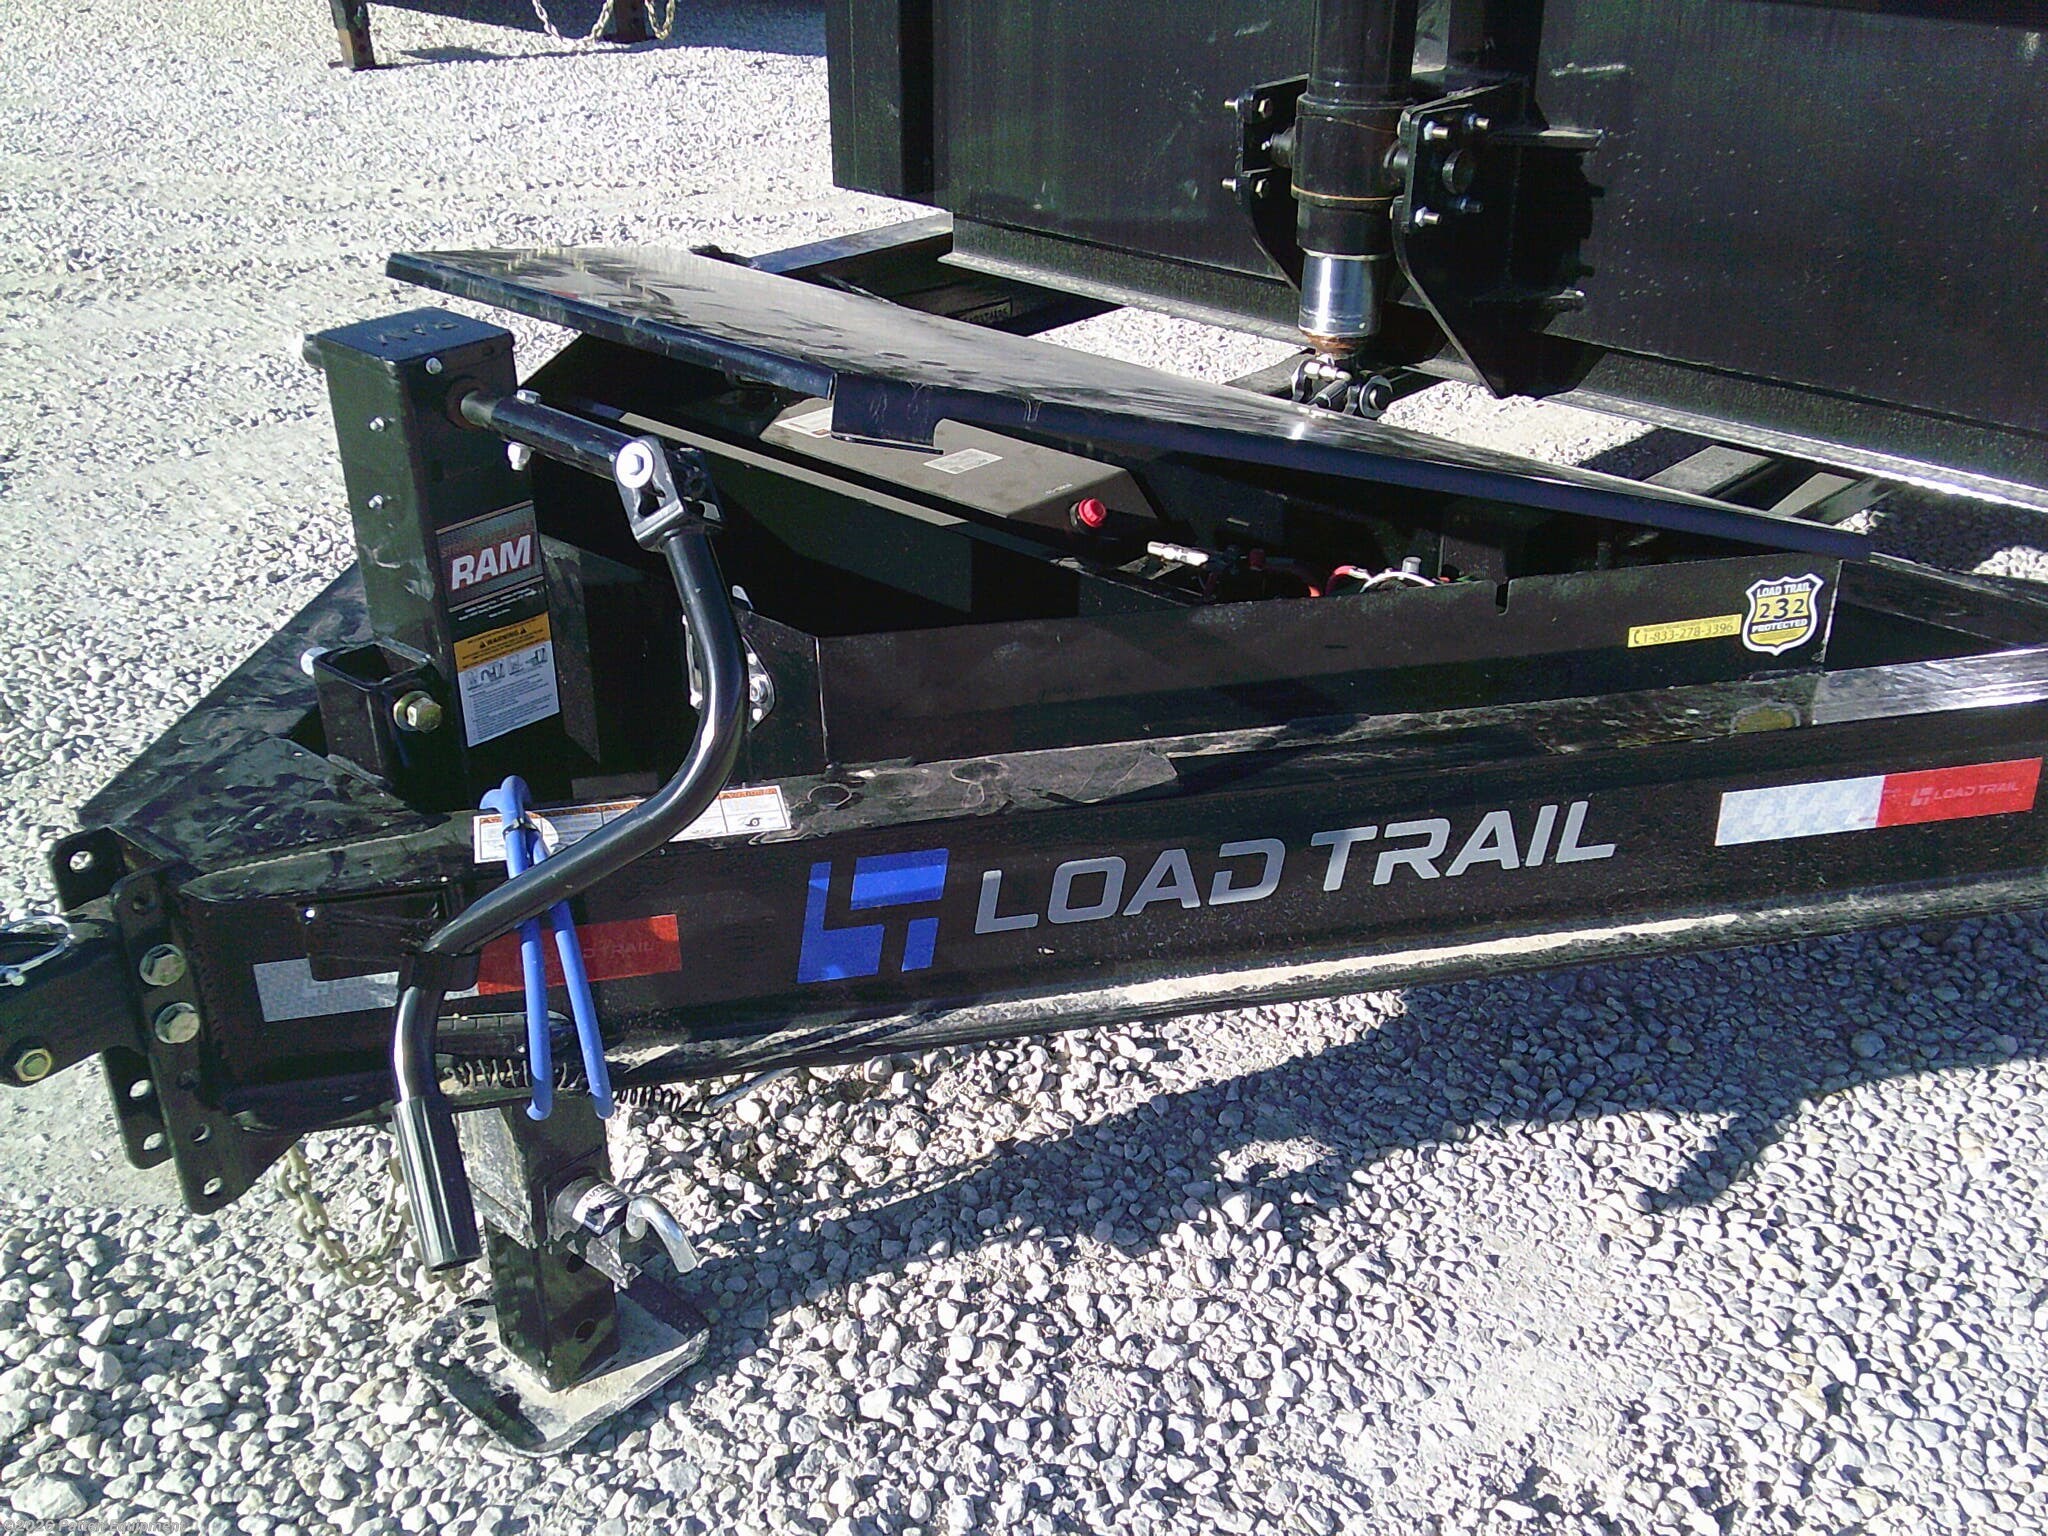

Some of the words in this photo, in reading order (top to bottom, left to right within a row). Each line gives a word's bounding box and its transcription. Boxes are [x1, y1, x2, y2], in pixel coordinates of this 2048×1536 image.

[451, 534, 531, 591] RAM
[1756, 585, 1781, 598] LOAD
[1784, 582, 1812, 594] TRAIL
[1759, 598, 1804, 619] 232
[1643, 622, 1734, 644] 1-833-278-3396
[1751, 618, 1808, 633] PROTECTED
[1933, 785, 1978, 800] LOAD
[1978, 781, 2020, 795] TRAIL
[974, 836, 1286, 935] LOAD
[1310, 800, 1616, 892] TRAIL
